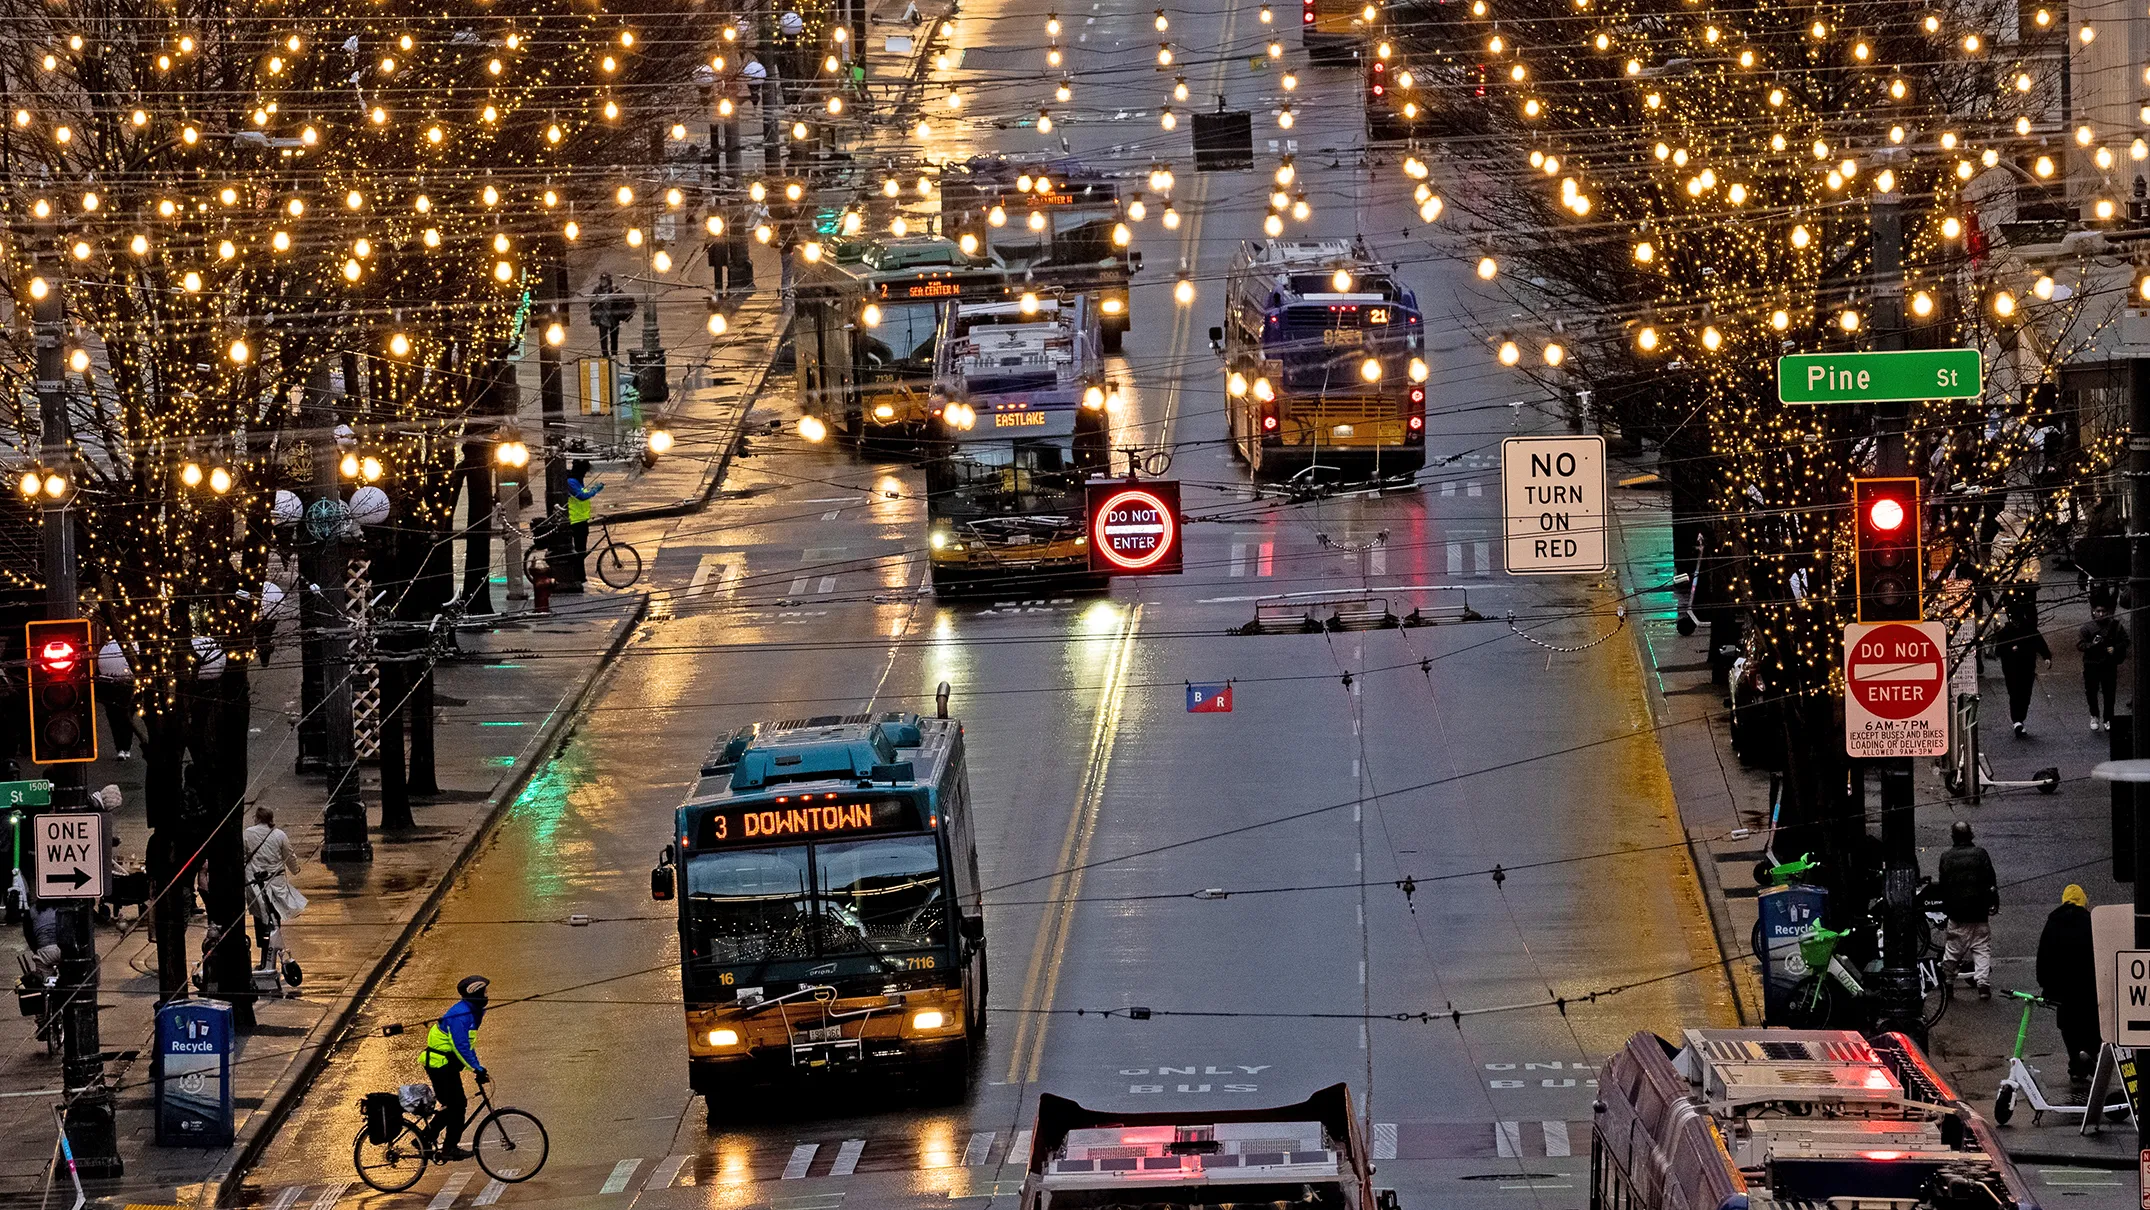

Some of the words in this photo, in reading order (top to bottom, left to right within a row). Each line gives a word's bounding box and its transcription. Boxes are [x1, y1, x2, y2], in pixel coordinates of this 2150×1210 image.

[881, 283, 888, 298] 2
[909, 286, 924, 297] SEA
[925, 284, 952, 296] CENTER
[953, 284, 960, 295] W
[1370, 309, 1388, 323] 21
[1807, 365, 1870, 391] Pine
[1936, 368, 1958, 387] St
[995, 411, 1045, 427] EASTLAKE
[1531, 452, 1576, 477] NO
[1524, 485, 1582, 504] TURN
[1109, 510, 1127, 522] DO
[1132, 509, 1158, 522] NOT
[1540, 512, 1569, 531] ON
[1113, 536, 1155, 549] ENTER
[1535, 539, 1577, 558] RED
[1861, 643, 1885, 658] DO
[1895, 642, 1930, 657] NOT
[1194, 691, 1202, 703] B
[1216, 696, 1225, 708] R
[1868, 686, 1924, 702] ENTER
[1881, 731, 1905, 740] BUSES
[1906, 730, 1921, 739] AND
[1922, 729, 1944, 739] BIKES
[1851, 740, 1885, 750] LOADING
[1887, 740, 1898, 749] OR
[1900, 739, 1944, 748] DELIVERIES
[29, 782, 48, 792] 1500
[10, 790, 24, 803] St
[714, 815, 727, 839] 3
[744, 803, 872, 837] DOWNTOWN
[47, 822, 89, 840] ONE
[46, 844, 91, 862] WAY
[906, 956, 935, 970] 7116
[719, 972, 734, 986] 16
[172, 1040, 213, 1053] Recycle
[1119, 1065, 1272, 1076] ONLY
[1485, 1061, 1601, 1070] ONL
[1129, 1084, 1258, 1094] BUS
